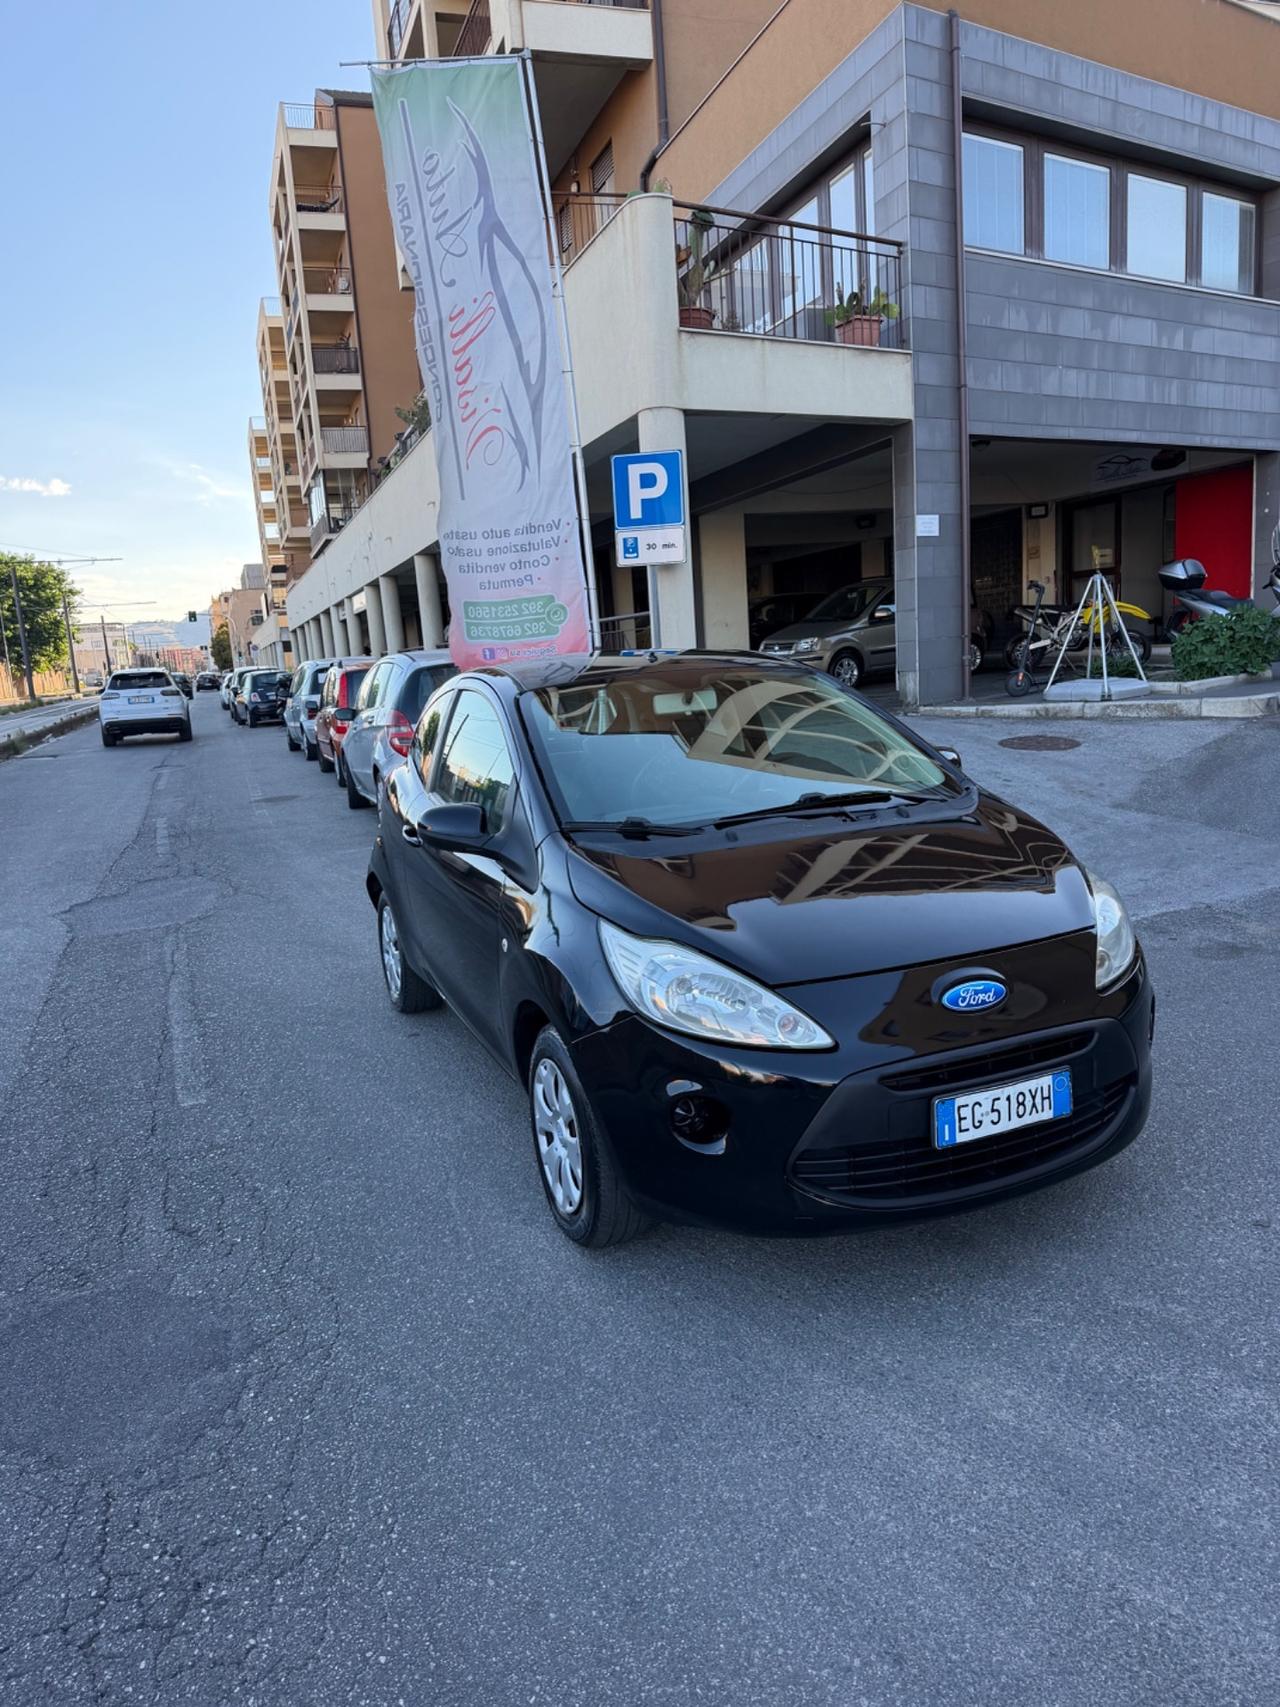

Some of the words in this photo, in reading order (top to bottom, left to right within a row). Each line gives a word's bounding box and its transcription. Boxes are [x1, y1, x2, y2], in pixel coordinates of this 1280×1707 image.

[627, 462, 668, 519] P
[646, 543, 657, 551] 30
[957, 985, 997, 1007] Ford
